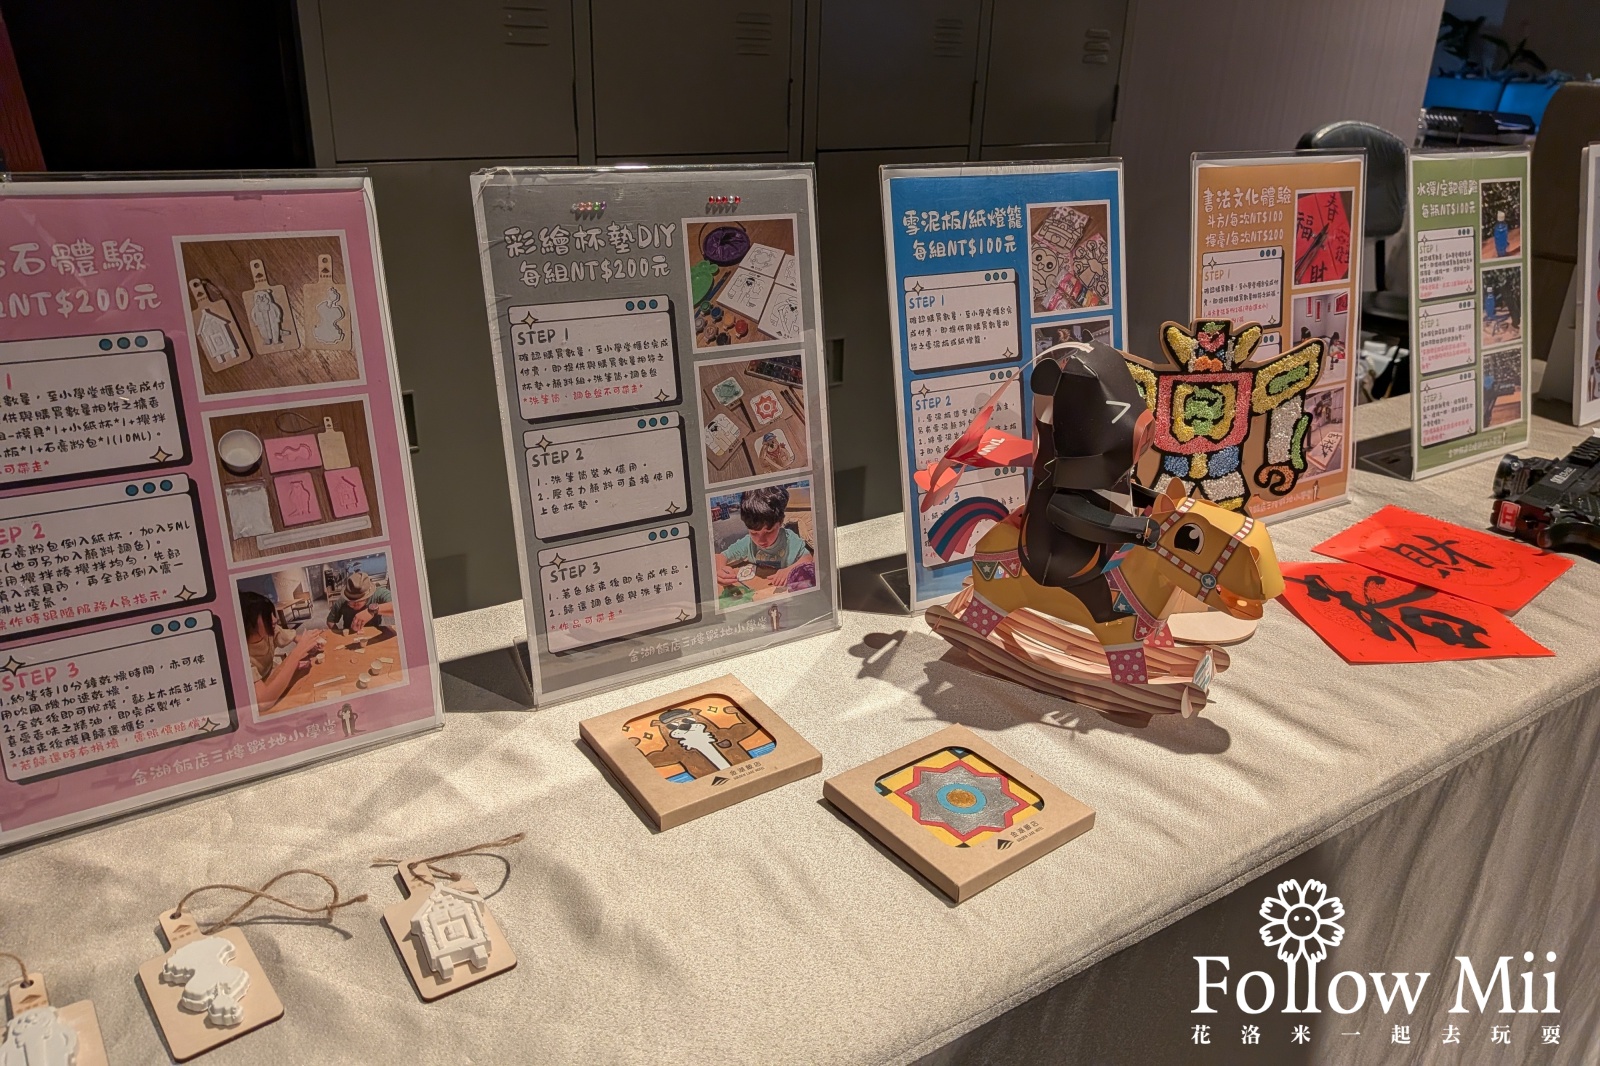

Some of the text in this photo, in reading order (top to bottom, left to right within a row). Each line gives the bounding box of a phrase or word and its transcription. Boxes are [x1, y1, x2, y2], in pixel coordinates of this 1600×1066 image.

[1203, 185, 1292, 213] 書法文化體驗
[902, 204, 1023, 236] 雪泥板/紙燈籠
[504, 221, 676, 258] 彩繪杯墊DIY
[913, 235, 1017, 261] 每組NT$100元
[0, 238, 147, 277] 石體驗
[520, 255, 671, 288] 每組NT$200元
[1204, 270, 1224, 281] STEP
[0, 284, 162, 319] NT$200元
[909, 295, 945, 309] STEP 1
[517, 328, 569, 346] STEP 1
[0, 377, 165, 408] 數量，至小學堂櫃台完成付
[915, 395, 951, 411] STEP 2
[0, 459, 49, 475] 可帶走
[531, 448, 584, 467] STEP 2
[32, 523, 45, 539] 2
[0, 540, 161, 574] (也可另加入顏料調色)。
[0, 549, 181, 588] 用攪拌棒攪拌均勻，先部
[550, 561, 600, 583] STEP 3
[2, 662, 79, 692] STEP 3
[131, 718, 337, 786] 金湖飯店三樓戰地小學堂
